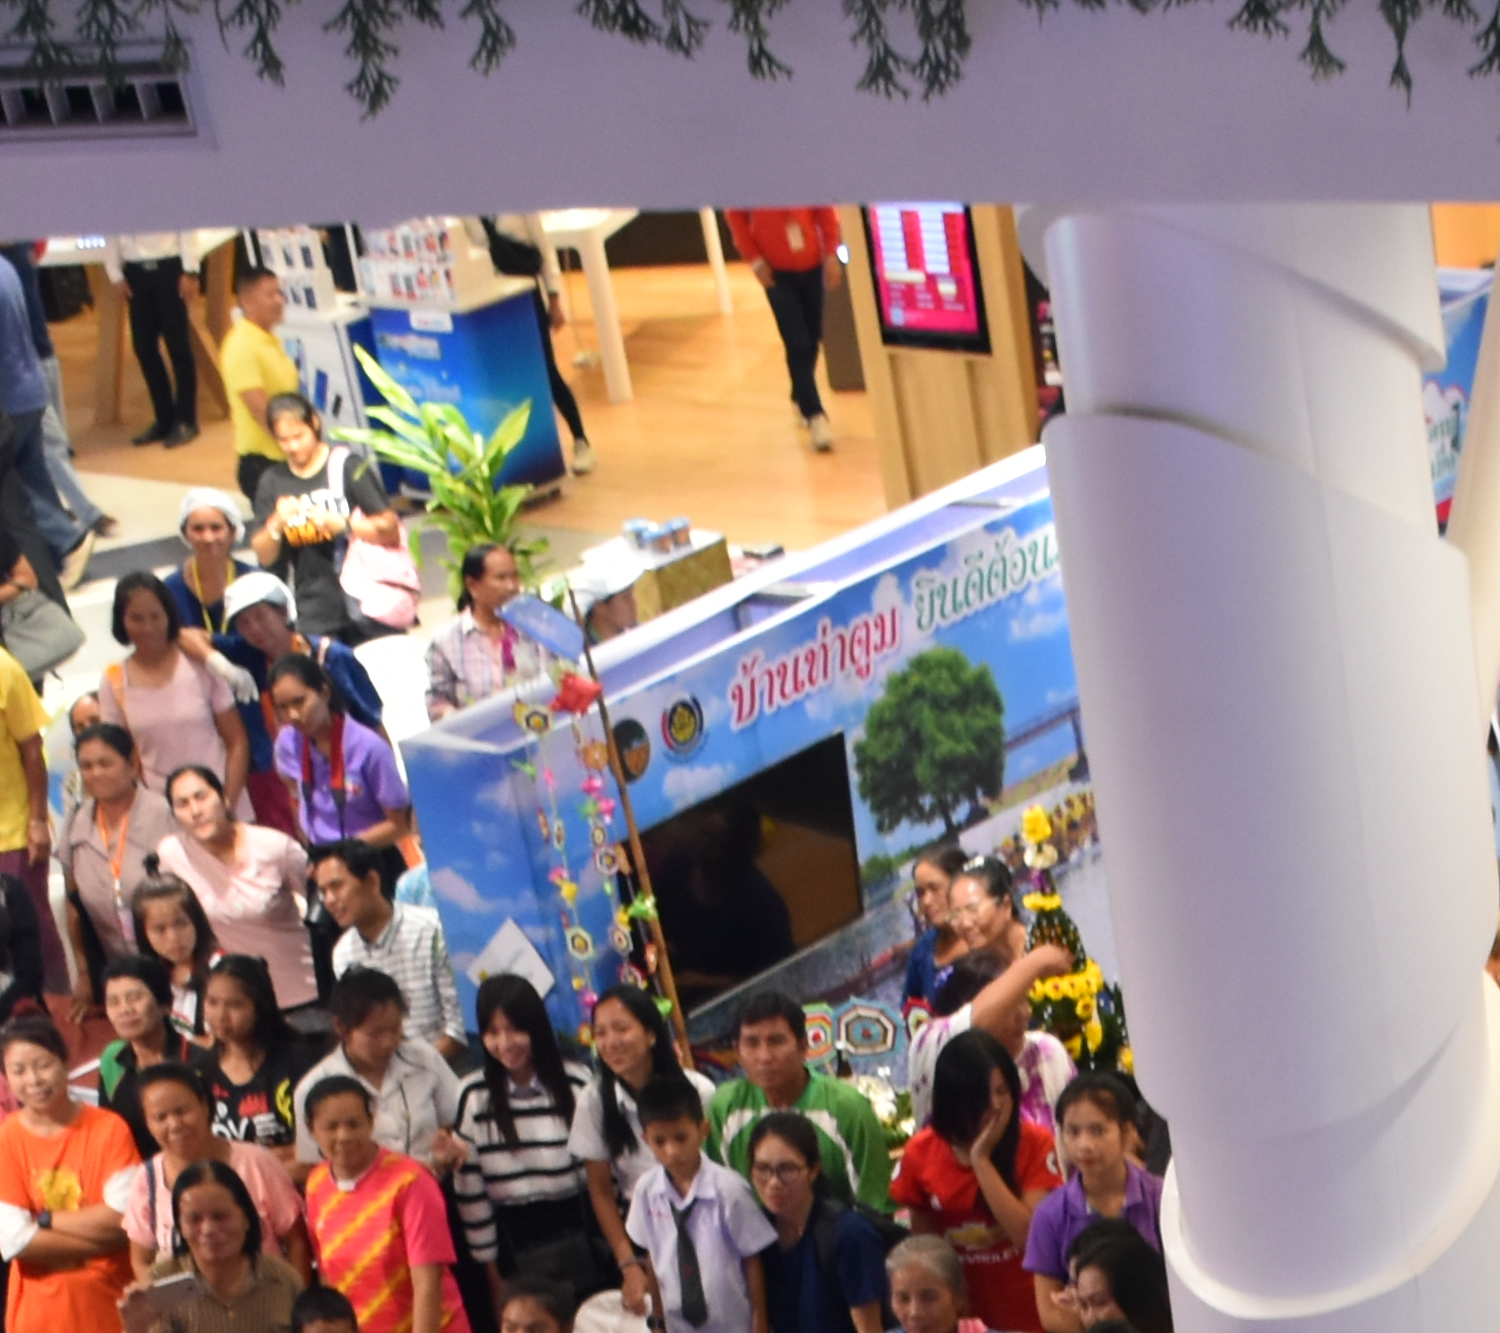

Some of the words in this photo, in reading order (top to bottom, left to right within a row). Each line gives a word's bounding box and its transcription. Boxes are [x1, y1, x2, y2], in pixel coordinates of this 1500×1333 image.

[731, 608, 898, 725] บ้านท่าตูม
[915, 535, 1062, 632] ยินดีต้อน
